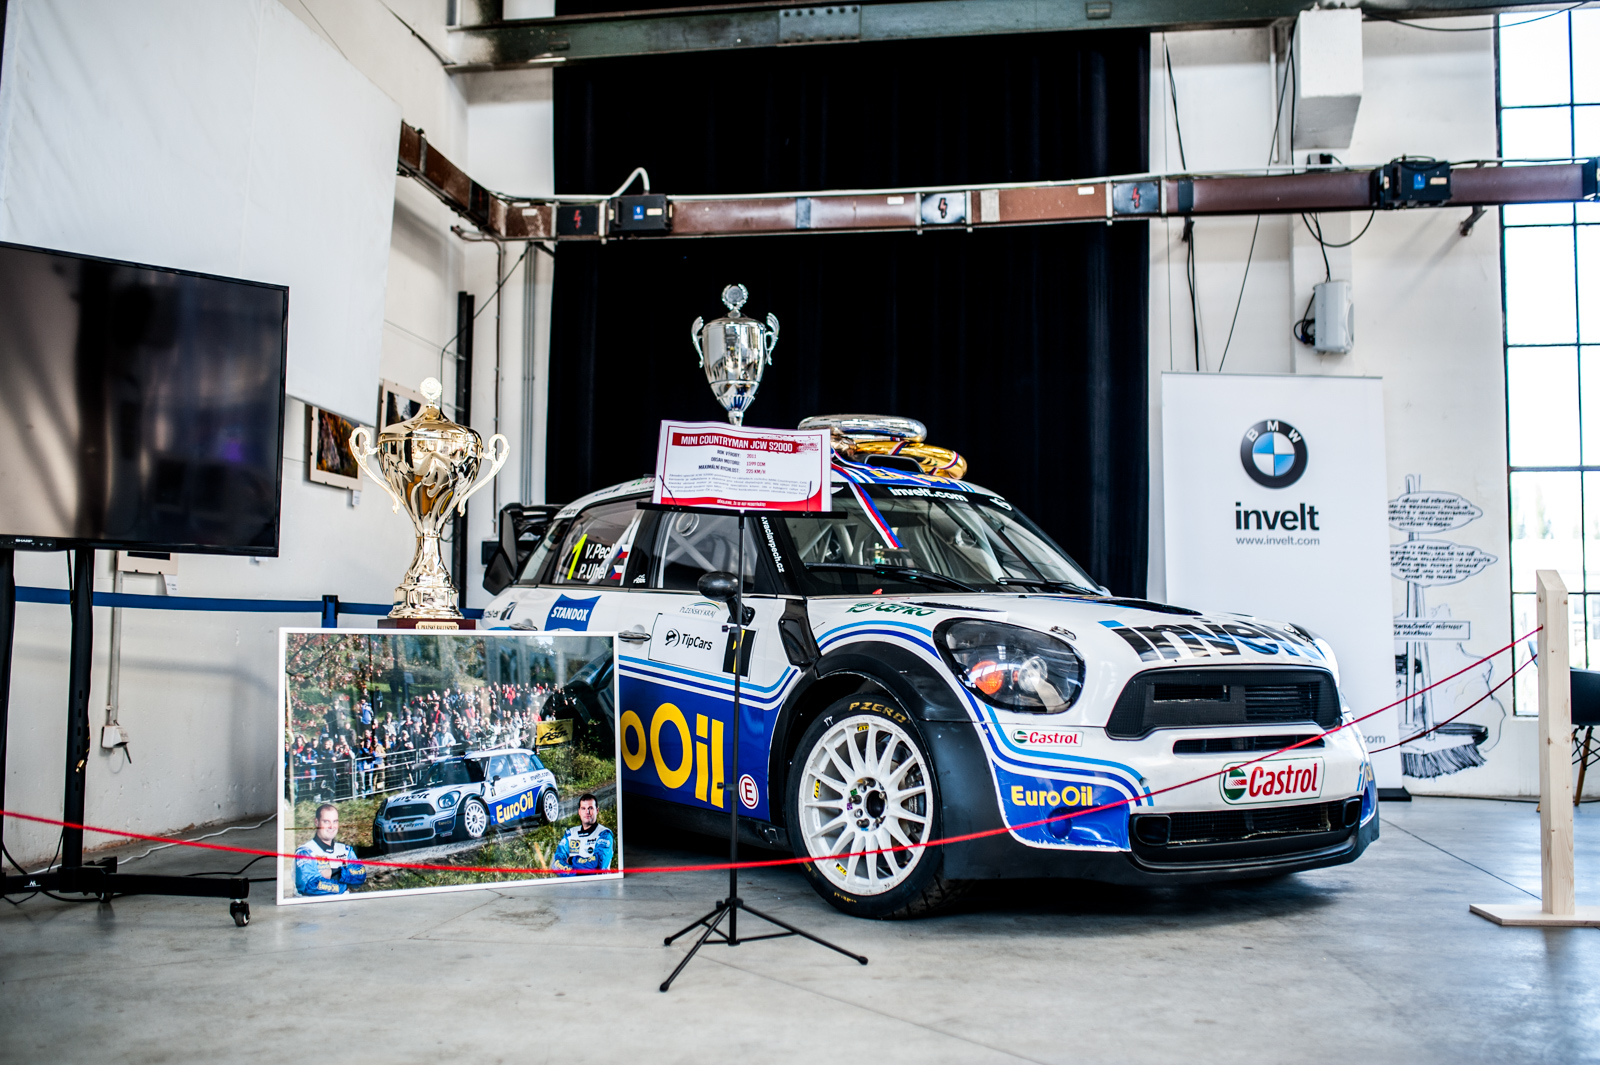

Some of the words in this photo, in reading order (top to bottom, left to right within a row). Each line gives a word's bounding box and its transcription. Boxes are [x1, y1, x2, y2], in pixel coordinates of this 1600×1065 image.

[1246, 421, 1302, 443] BMW
[680, 435, 698, 445] MINI
[699, 436, 749, 449] COUNTRYMAN
[750, 440, 767, 450] JCW
[769, 441, 793, 452] S2000
[887, 487, 969, 502] invelt.com
[1235, 502, 1320, 531] invelt
[1236, 536, 1320, 546] www.invelt.com
[567, 534, 588, 580] 1
[585, 543, 616, 559] V.Pech
[551, 606, 590, 621] STANDOX
[682, 633, 713, 650] TipCars
[1030, 732, 1078, 744] Castrol
[1249, 763, 1317, 797] Castrol
[1011, 786, 1093, 806] EuroOil
[496, 791, 533, 823] EuroOil
